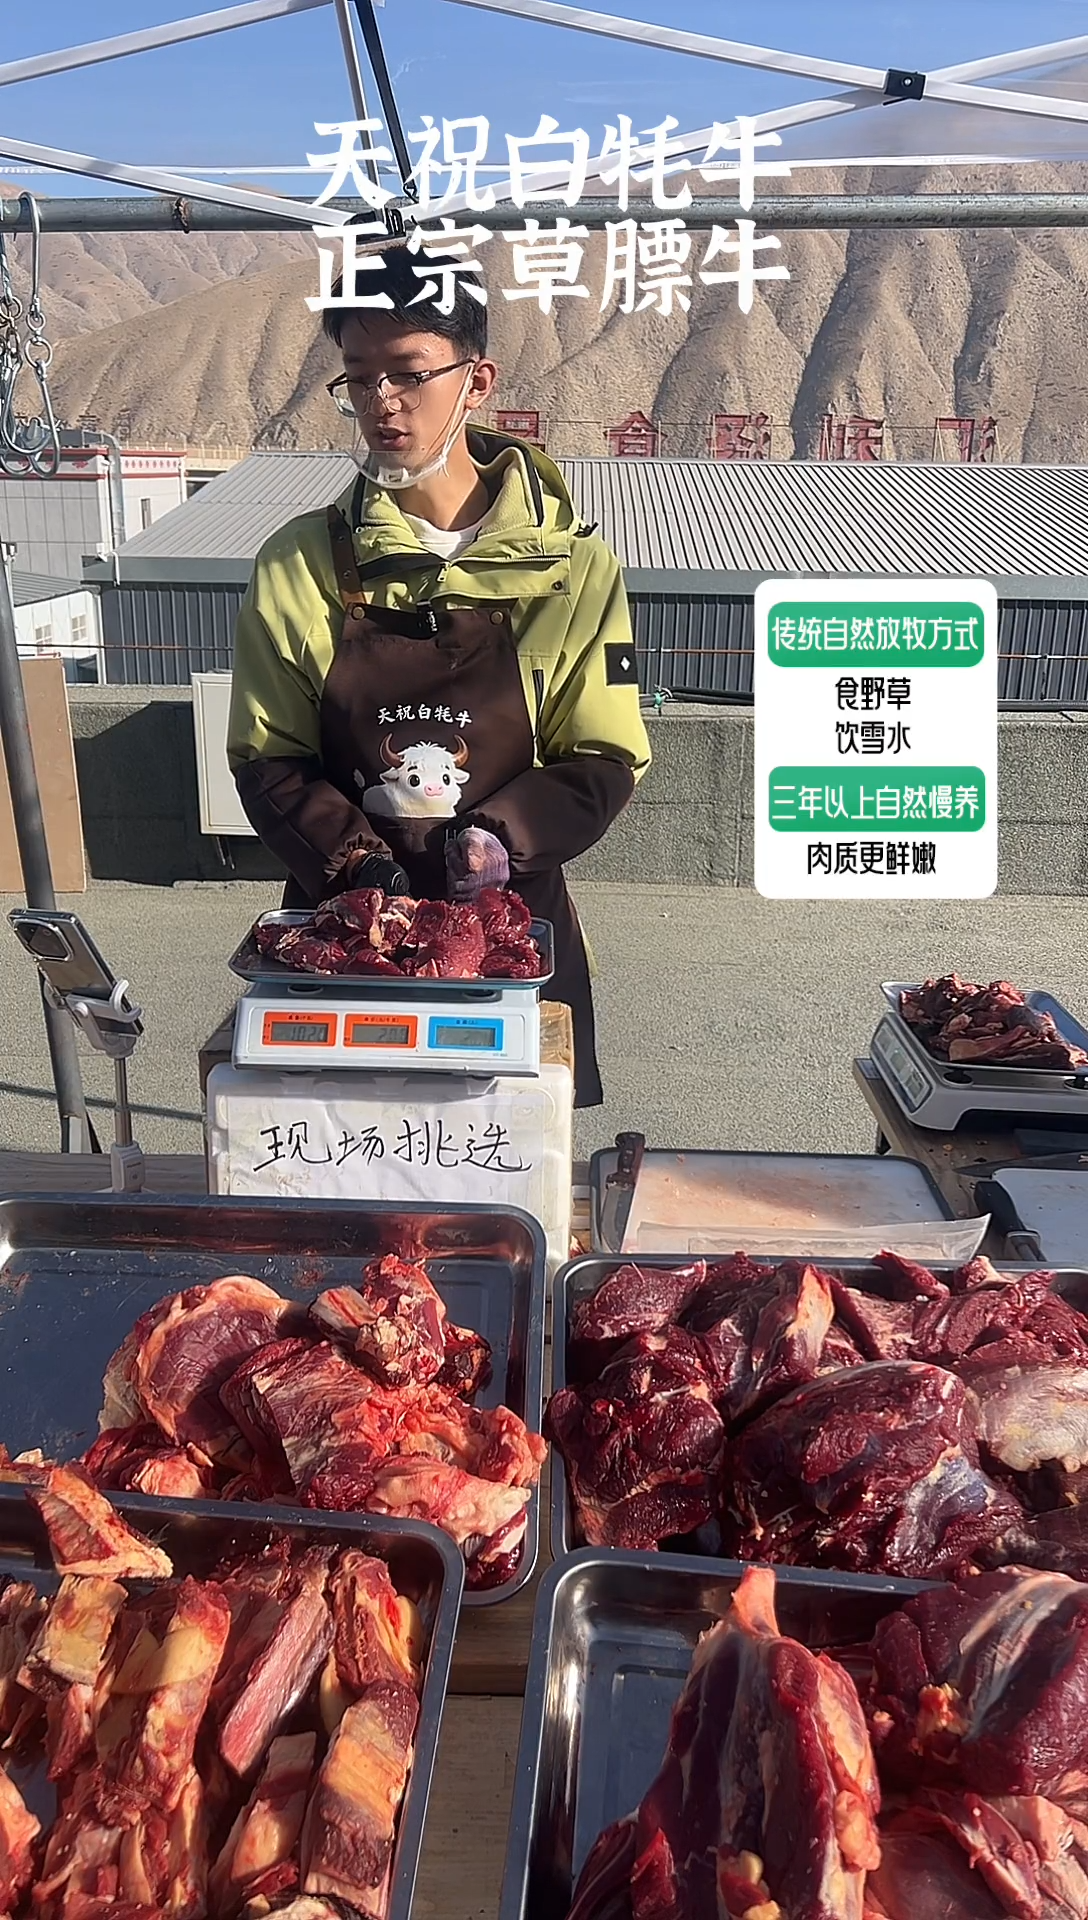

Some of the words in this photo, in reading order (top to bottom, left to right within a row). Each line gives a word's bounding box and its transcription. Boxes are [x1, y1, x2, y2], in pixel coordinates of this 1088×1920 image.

[377, 703, 473, 728] 天祝白牦牛
[253, 1119, 532, 1172] 现场挑选
